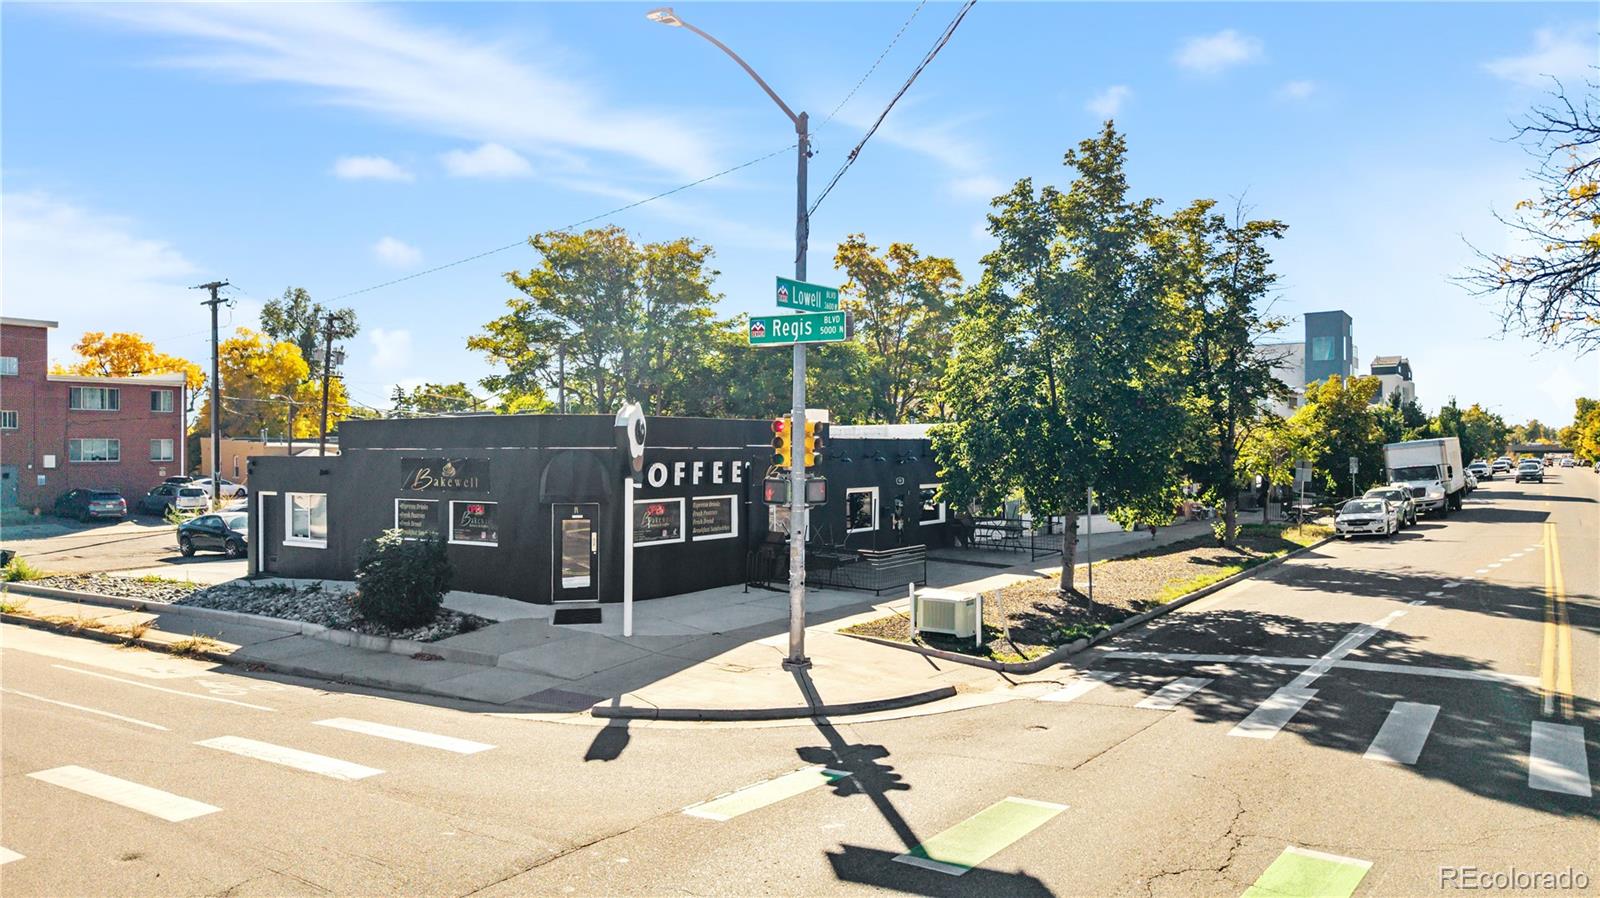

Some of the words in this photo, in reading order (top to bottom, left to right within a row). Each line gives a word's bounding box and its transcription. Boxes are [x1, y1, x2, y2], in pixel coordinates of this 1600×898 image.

[792, 286, 822, 309] Lowell
[826, 290, 837, 300] BLVD
[772, 318, 813, 341] Regis
[820, 326, 837, 335] 5000
[839, 325, 844, 333] N
[824, 315, 841, 325] BLVD
[411, 467, 479, 491] Bakewell
[633, 460, 742, 488] OFFEE
